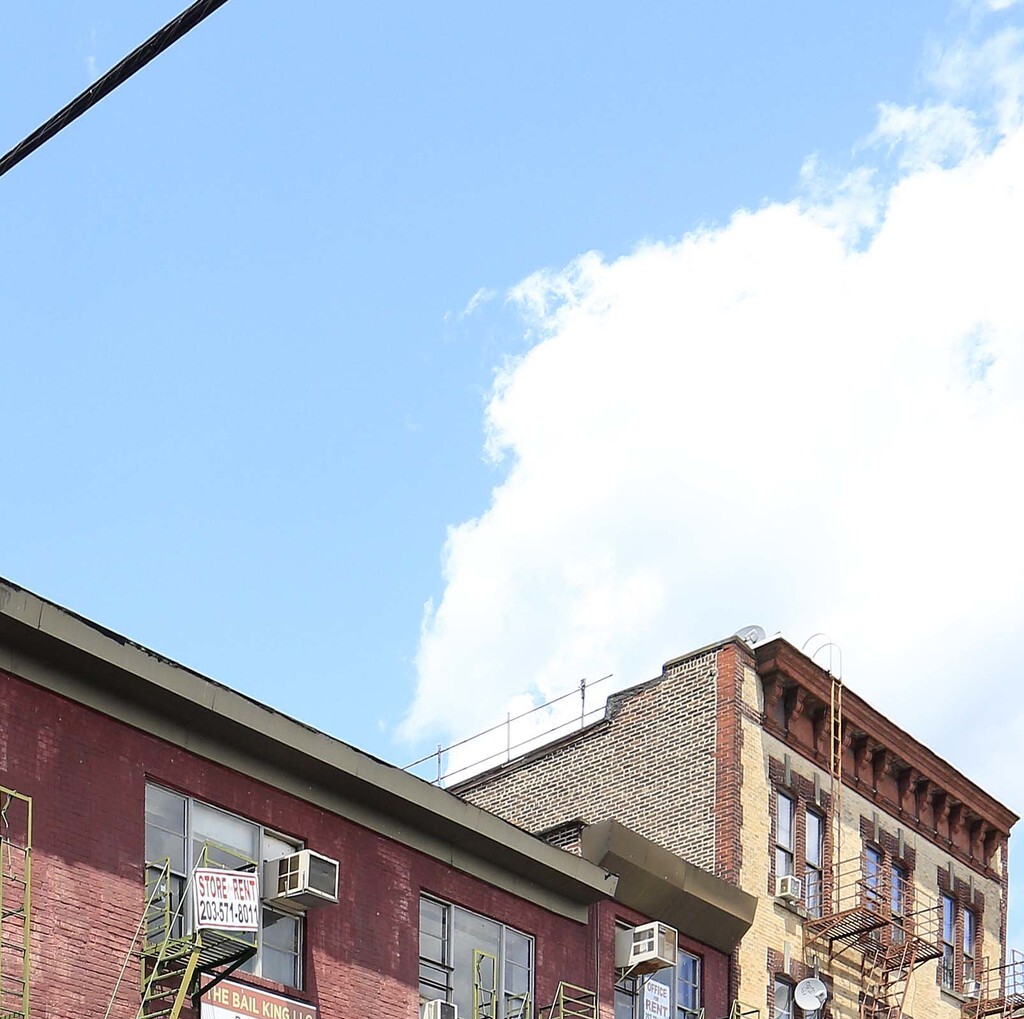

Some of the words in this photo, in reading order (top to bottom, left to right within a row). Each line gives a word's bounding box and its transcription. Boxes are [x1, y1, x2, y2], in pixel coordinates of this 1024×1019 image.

[199, 875, 227, 899] STORE
[233, 878, 255, 901] RENT
[207, 986, 229, 1005] THE
[232, 992, 259, 1015] BAIL
[647, 981, 667, 998] OFFICE
[646, 999, 668, 1017] RENT
